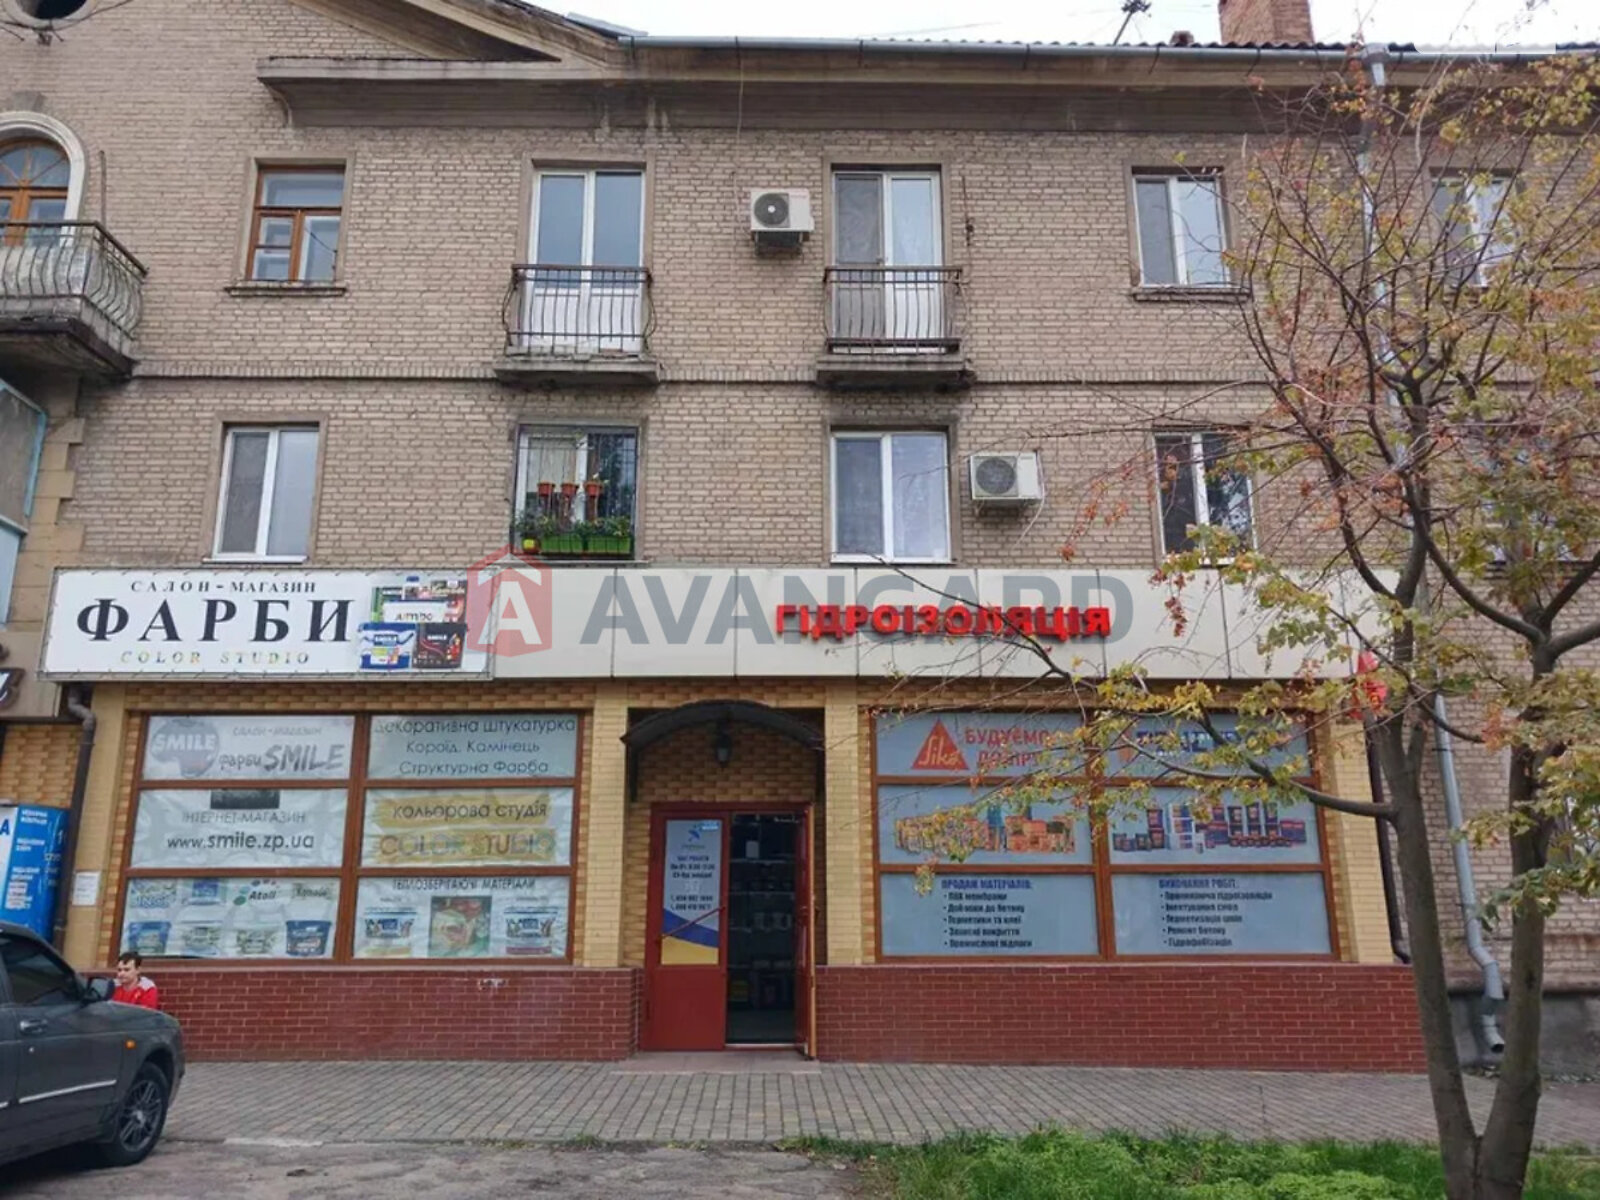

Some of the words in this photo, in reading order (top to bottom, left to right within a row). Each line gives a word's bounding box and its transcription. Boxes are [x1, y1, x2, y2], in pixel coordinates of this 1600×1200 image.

[77, 598, 355, 643] ФАРБИ
[776, 604, 1110, 642] ГІДРОІЗОЛЯЦІЯ
[120, 650, 202, 665] COLOR
[220, 650, 311, 665] STUDIO
[153, 734, 217, 753] SMILE
[466, 740, 541, 753] Камінець
[917, 735, 961, 767] Sika
[263, 744, 346, 773] SMILE
[399, 760, 490, 776] Структурна
[493, 759, 549, 774] Фарба
[393, 804, 491, 822] кольорова
[167, 831, 316, 852] www.smile.zp.ua
